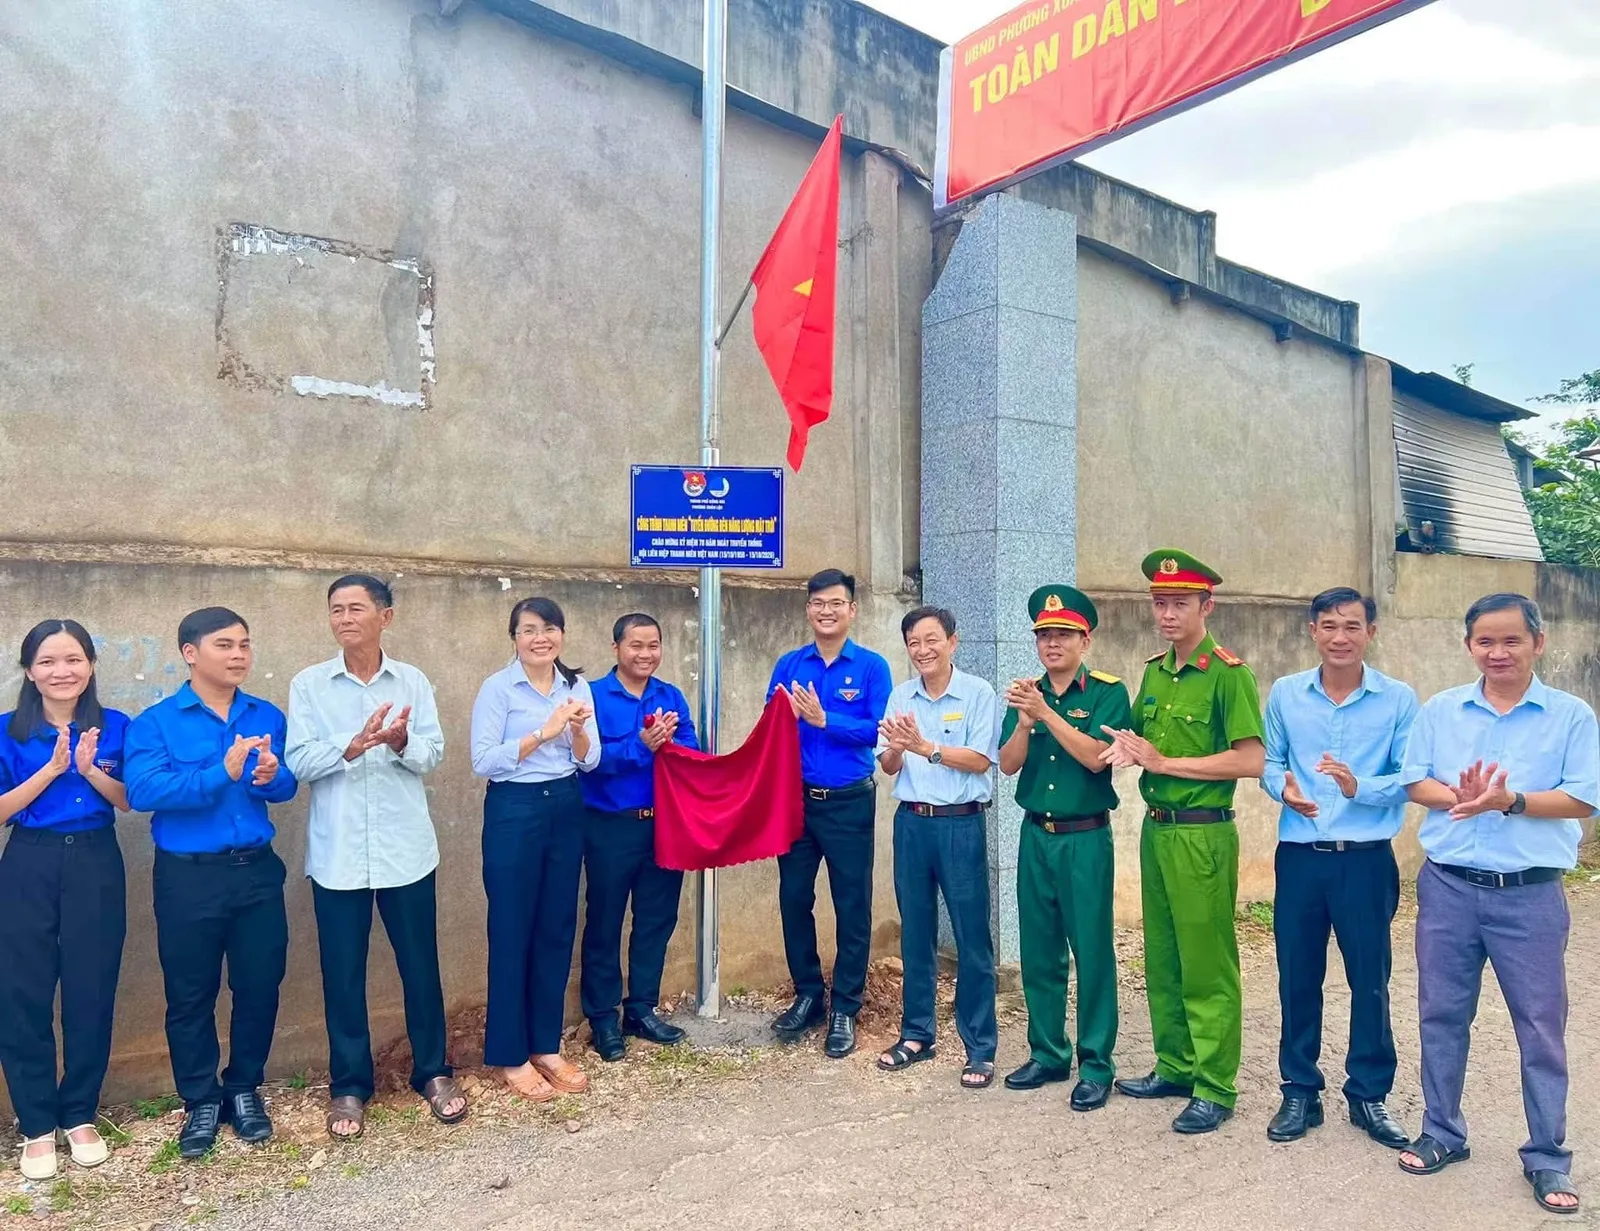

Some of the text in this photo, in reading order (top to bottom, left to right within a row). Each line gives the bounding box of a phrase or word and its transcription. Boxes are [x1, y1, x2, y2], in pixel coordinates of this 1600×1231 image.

[964, 34, 996, 67] UBND
[1053, 0, 1078, 16] XU
[969, 31, 1060, 113] TOÀN
